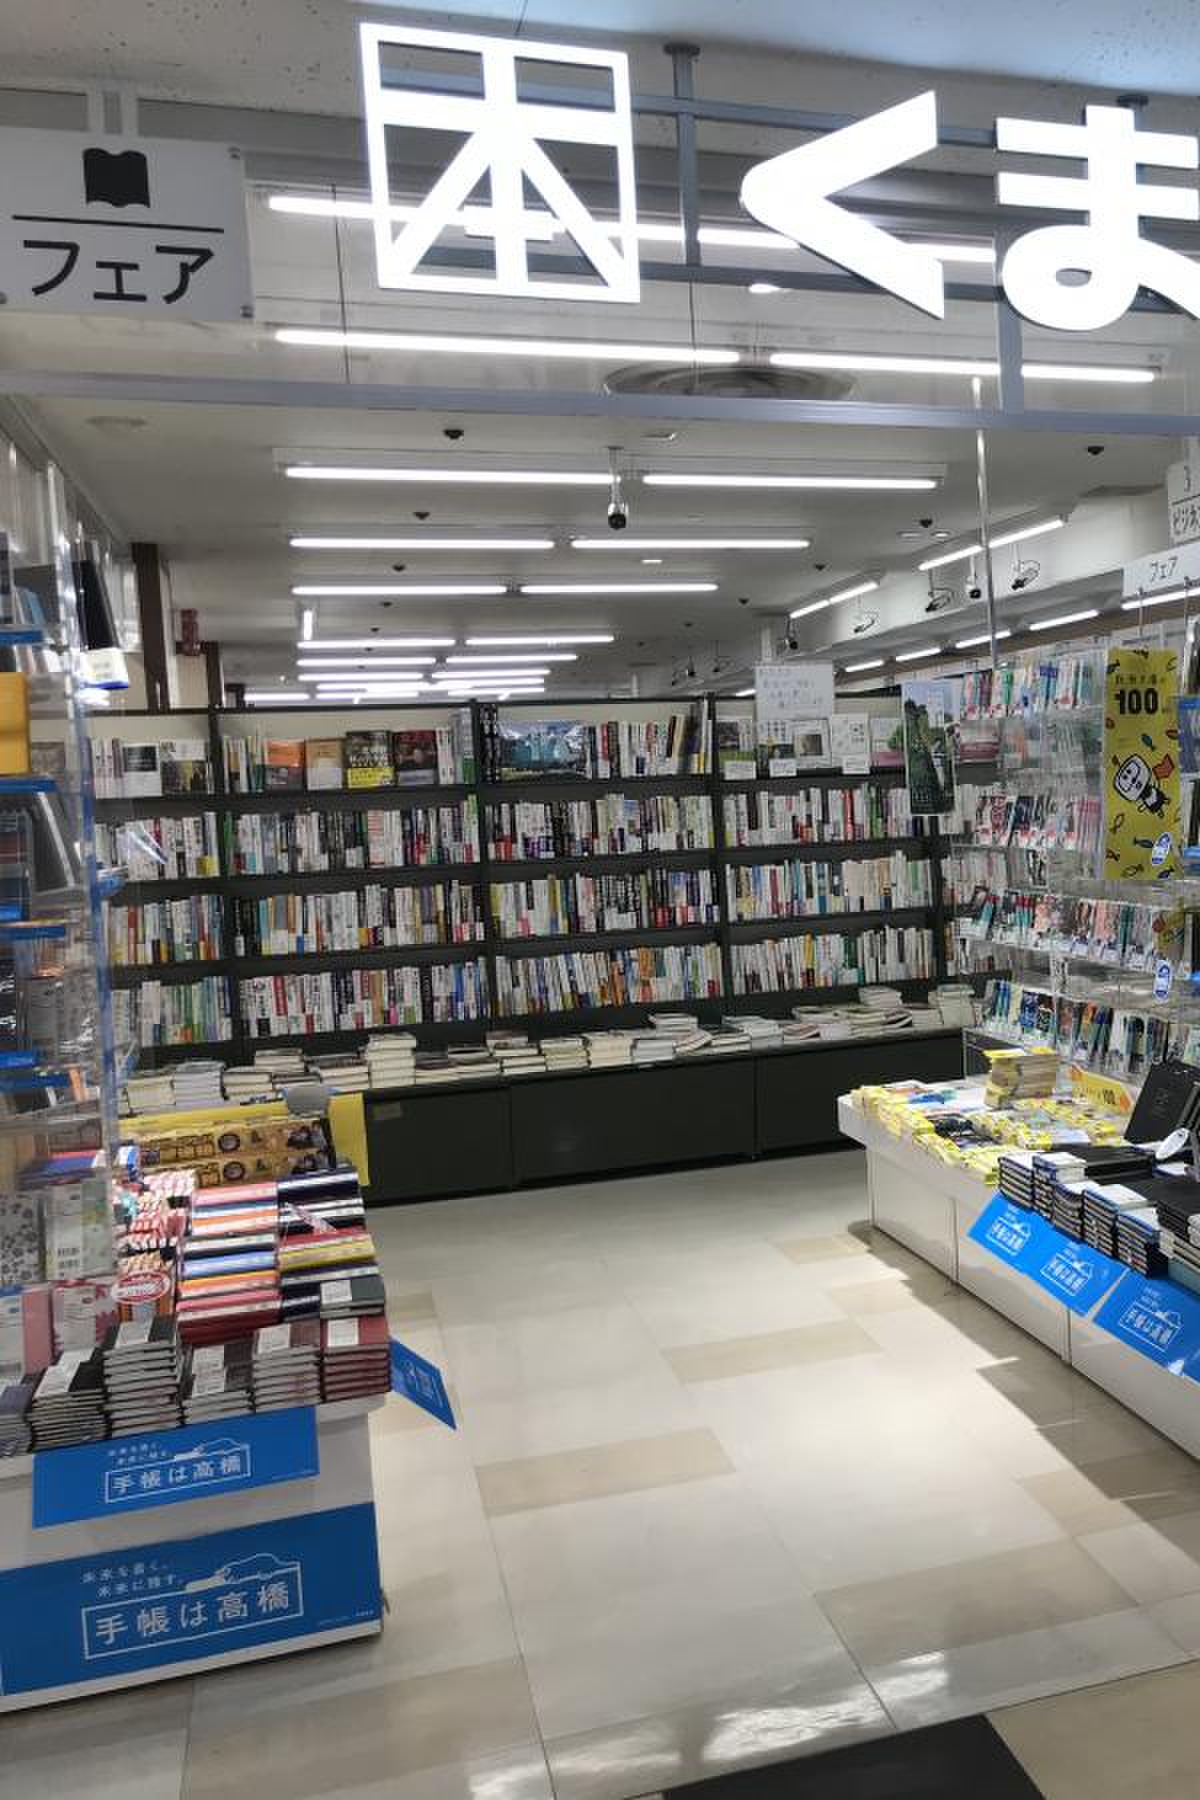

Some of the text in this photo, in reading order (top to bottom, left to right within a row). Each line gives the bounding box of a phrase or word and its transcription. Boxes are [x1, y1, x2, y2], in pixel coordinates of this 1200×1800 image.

[23, 239, 215, 304] フェア
[112, 1455, 241, 1494] 手帳は高橋
[95, 1581, 289, 1646] 手帳は高橋
